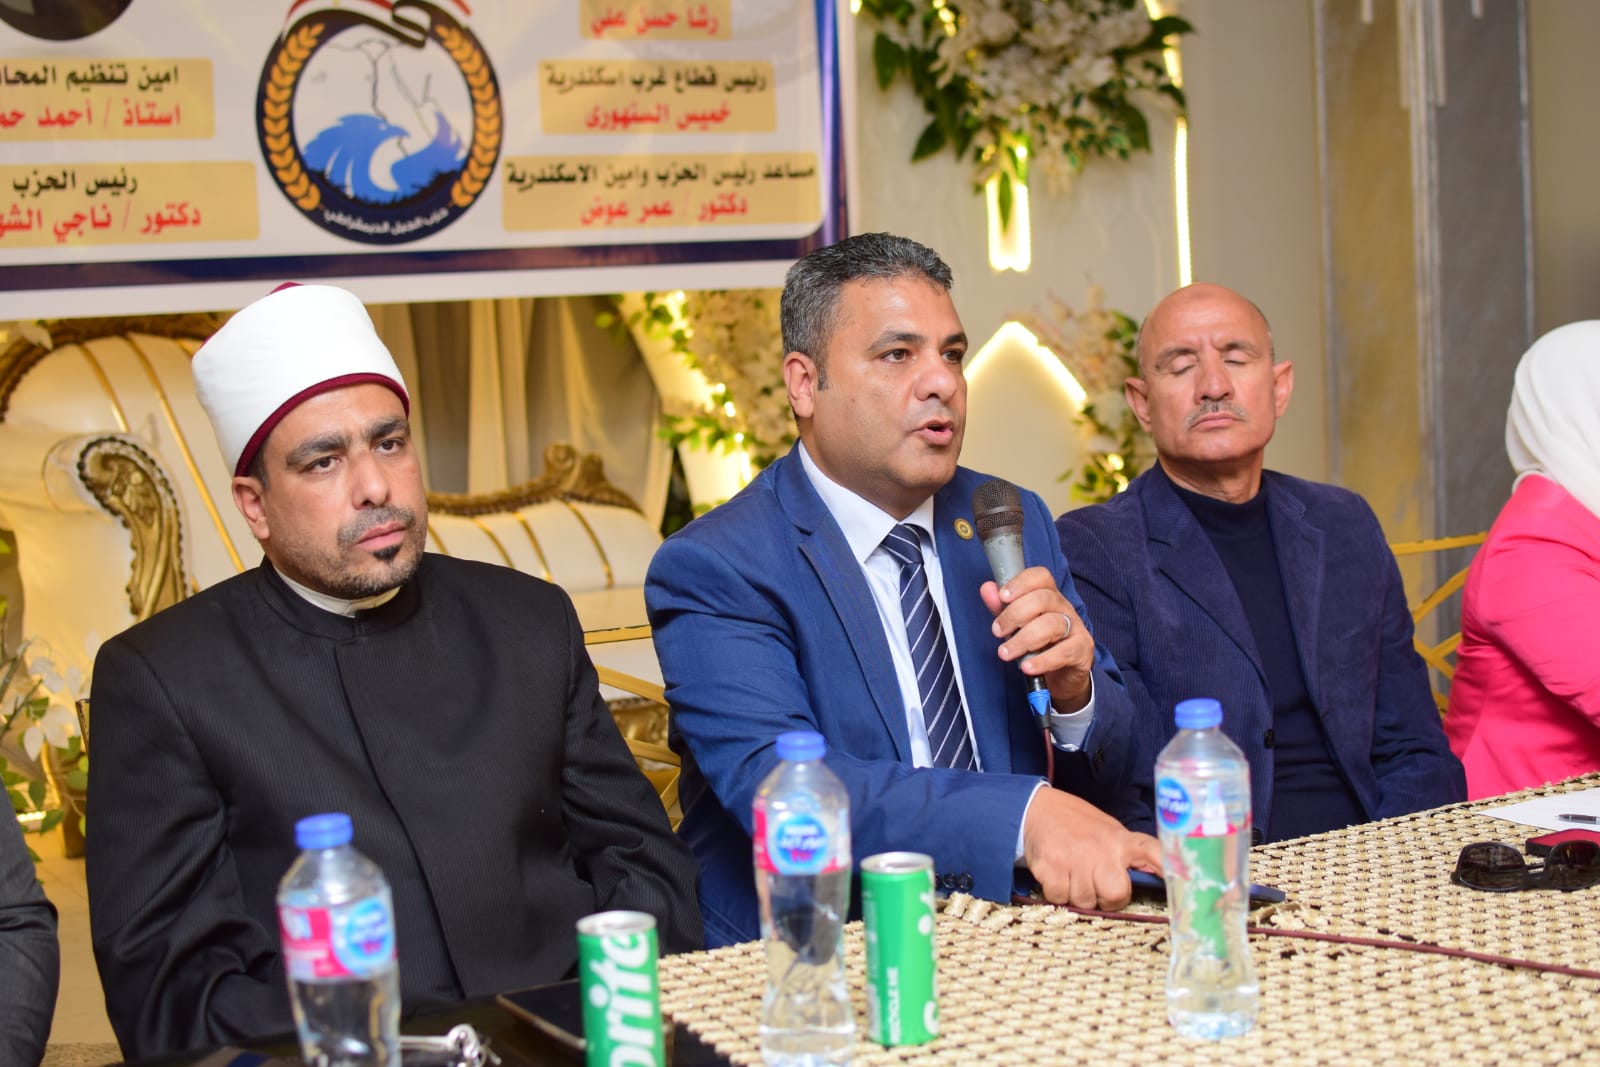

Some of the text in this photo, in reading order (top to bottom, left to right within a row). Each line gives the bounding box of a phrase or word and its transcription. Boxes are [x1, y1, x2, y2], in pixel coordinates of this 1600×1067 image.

[636, 7, 678, 36] حسن
[687, 4, 719, 36] رشا
[0, 64, 178, 92] امين تنظيم المحا
[546, 64, 767, 94] رئيس قطاع غرب اسكندرية
[0, 107, 26, 128] حم
[37, 98, 92, 128] أحمد
[123, 97, 181, 127] استاذ
[676, 101, 730, 129] خميس
[13, 167, 138, 198] رئيس الحزب
[506, 162, 598, 192] الاسكندرية
[656, 161, 707, 187] الحزب
[712, 161, 756, 186] رئيس
[762, 162, 815, 178] مساعد
[0, 203, 42, 240] الش
[139, 202, 201, 234] دكتور
[581, 195, 629, 226] عوض
[638, 200, 673, 224] عمر
[697, 192, 747, 222] دكتور
[53, 204, 112, 244] ناجي
